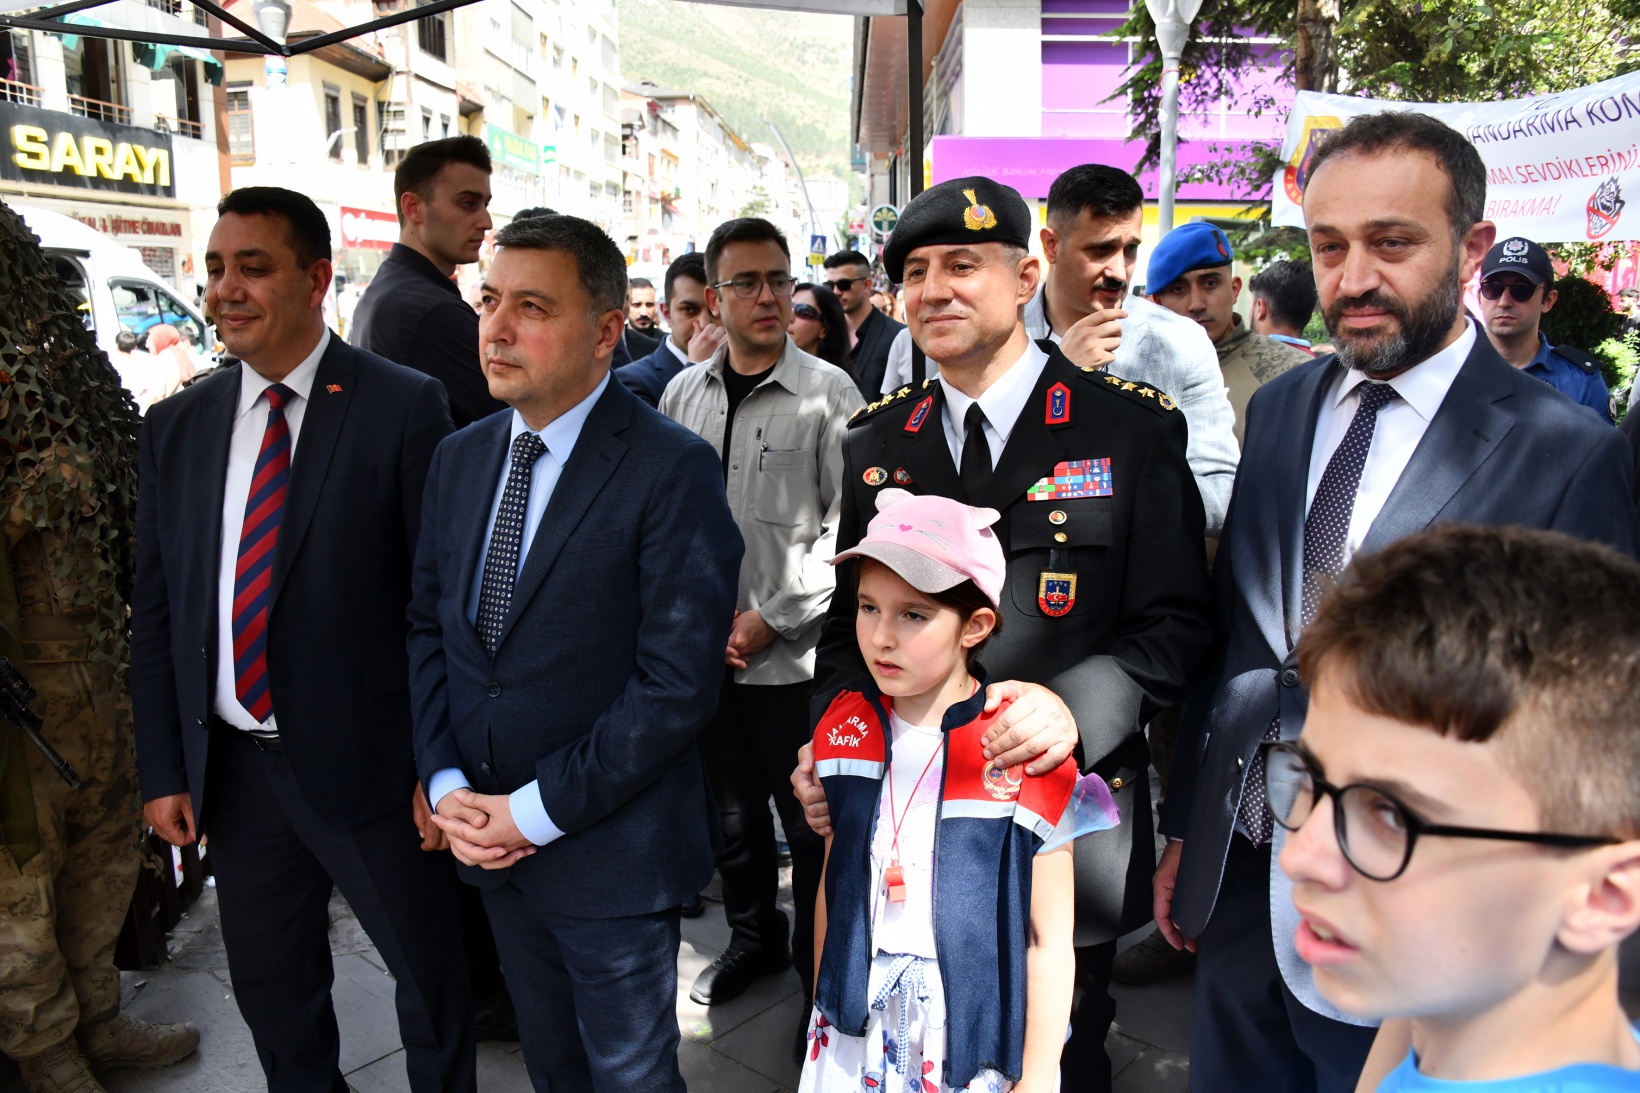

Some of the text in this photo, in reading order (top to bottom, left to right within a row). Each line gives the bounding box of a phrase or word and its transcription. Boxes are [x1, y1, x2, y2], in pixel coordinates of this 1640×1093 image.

[11, 124, 171, 186] SARAYI
[1516, 144, 1640, 185] SEVDİKLERİNİ
[1485, 194, 1563, 219] BIRAKMA!
